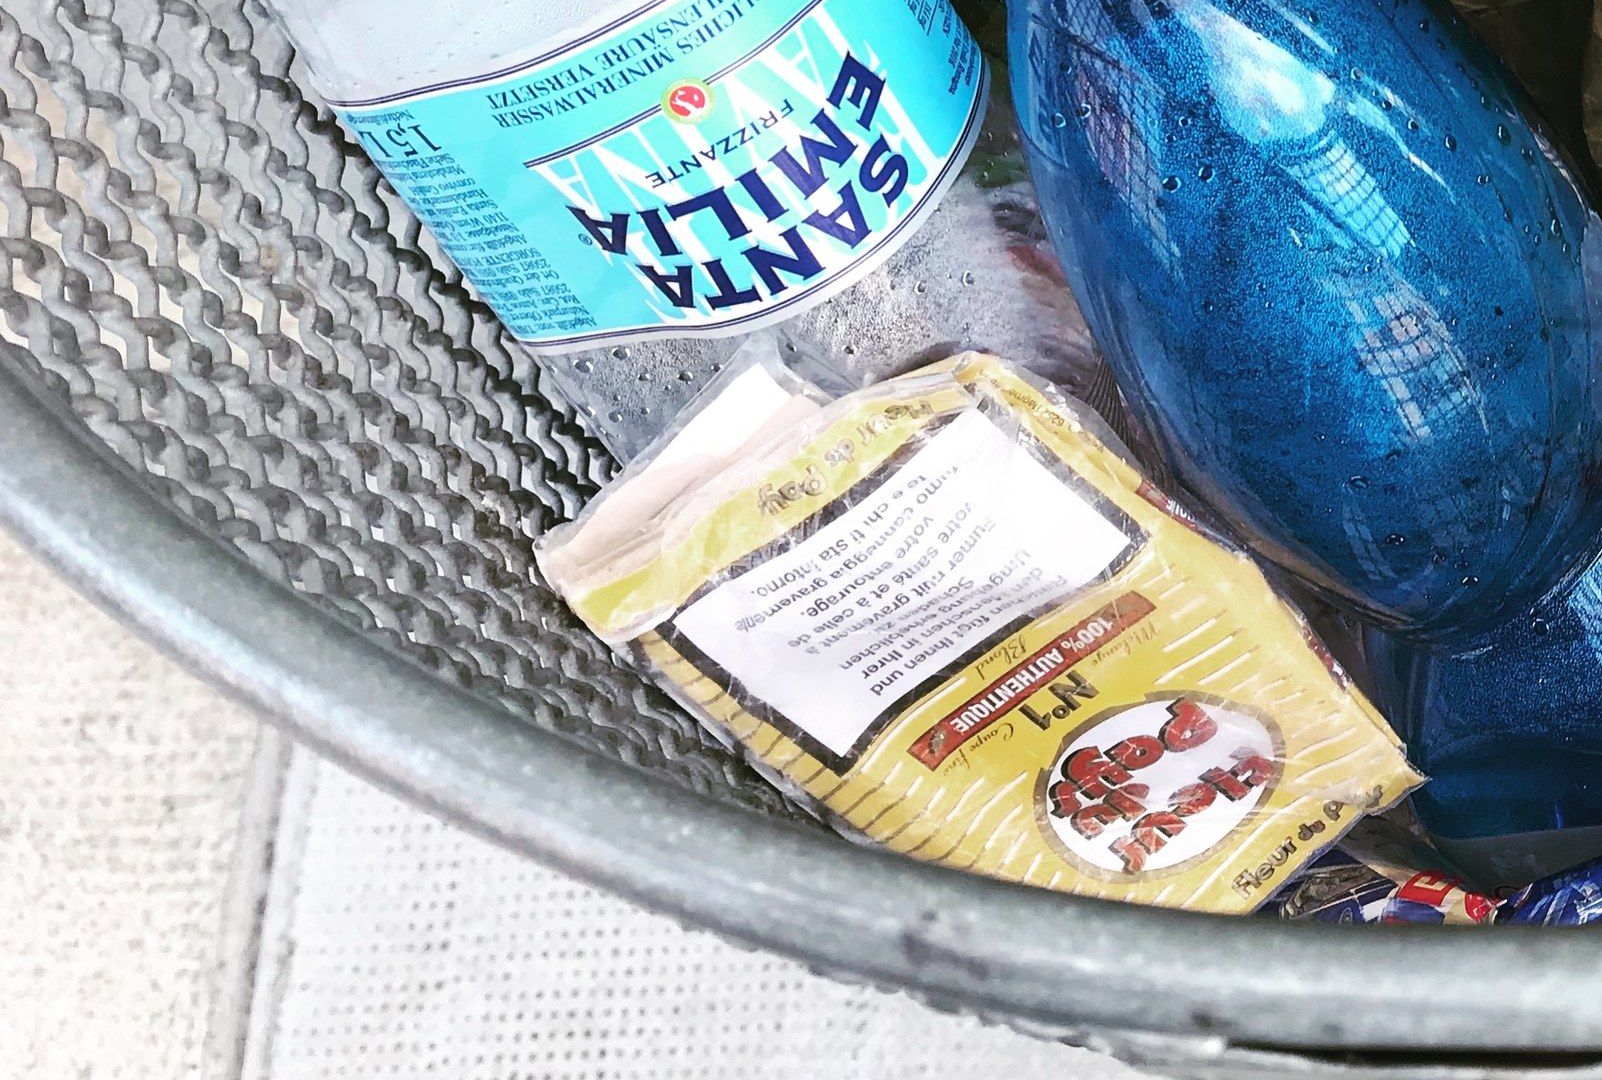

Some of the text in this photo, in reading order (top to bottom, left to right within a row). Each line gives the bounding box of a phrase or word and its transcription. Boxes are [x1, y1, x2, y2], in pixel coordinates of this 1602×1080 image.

[484, 63, 593, 112] VERSETZT
[492, 45, 676, 129] MINERALWASSER
[358, 118, 440, 161] 1,5 L
[565, 50, 884, 256] EMILIA
[644, 98, 794, 189] FRIZZANTE
[635, 134, 906, 311] SANTA
[818, 537, 849, 563] sta
[731, 573, 829, 635] gravemente
[800, 553, 893, 624] entourage.
[856, 596, 872, 613] à
[870, 581, 891, 601] et
[901, 635, 921, 653] in
[903, 634, 953, 673] Ihnen
[973, 634, 1028, 679] Blond
[1058, 613, 1115, 656] 100%
[860, 646, 903, 681] Ihrer
[870, 667, 905, 697] und
[946, 645, 1065, 736] AUTHENTIQUE
[1050, 697, 1216, 820] Pays
[1072, 787, 1149, 840] du
[1107, 744, 1277, 874] Fleur
[1230, 835, 1298, 899] Fleur
